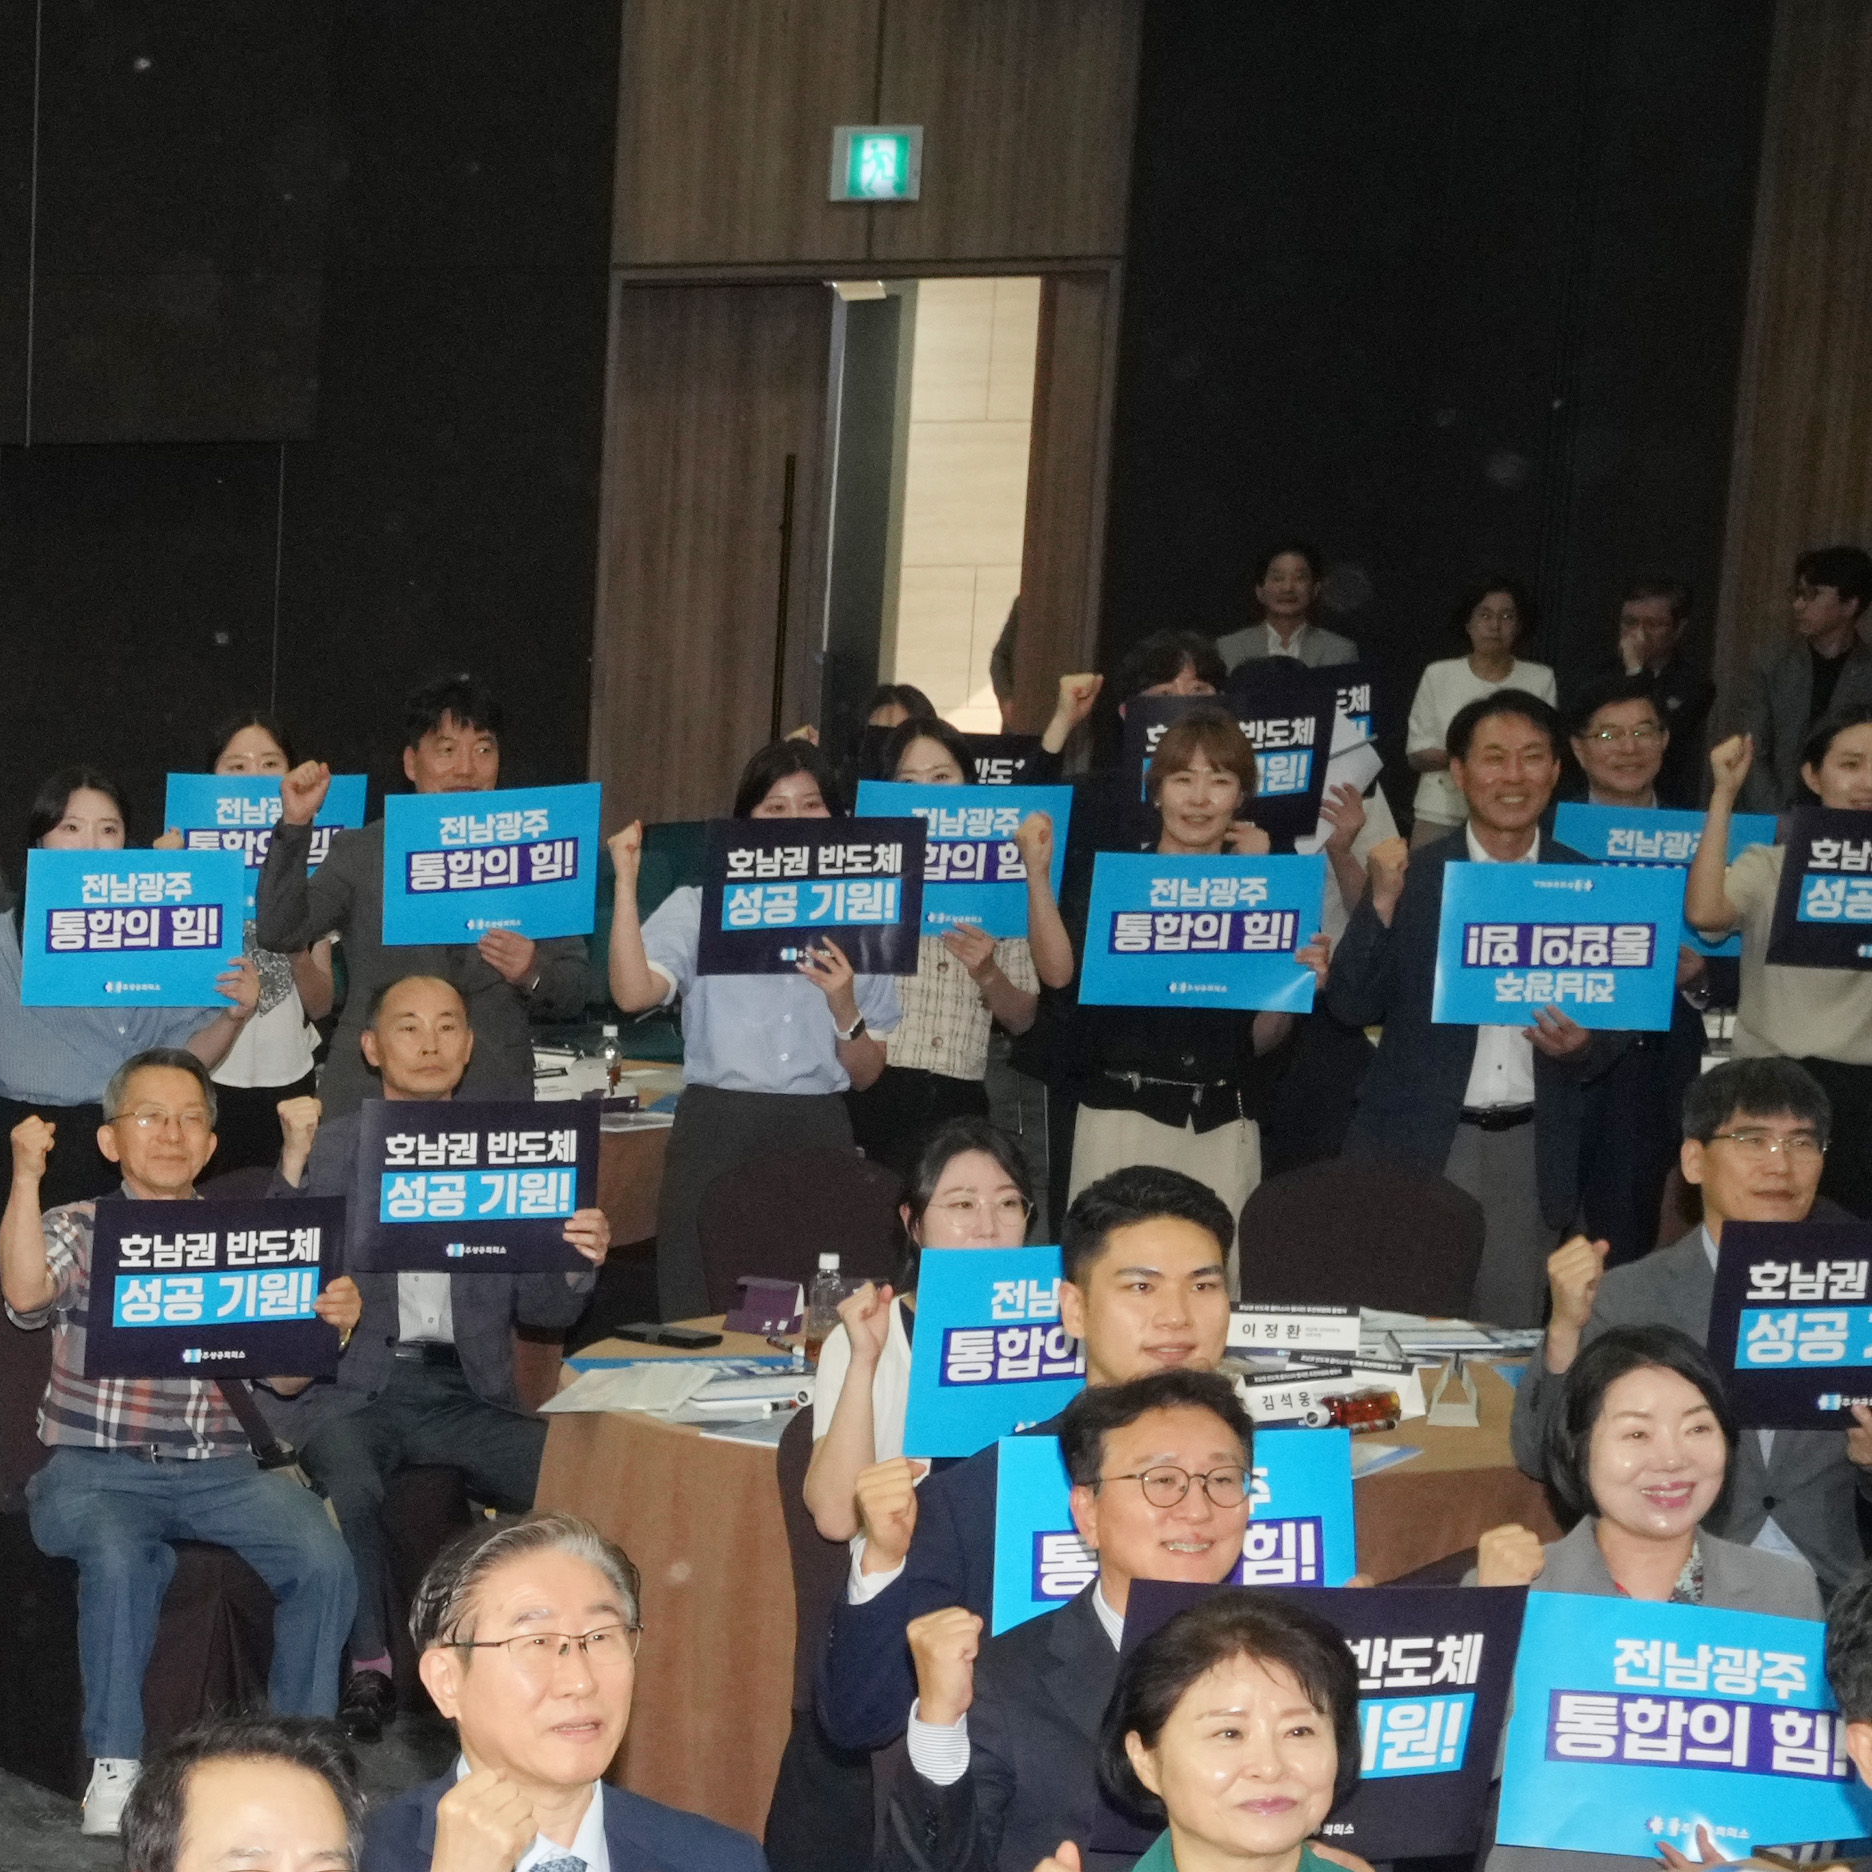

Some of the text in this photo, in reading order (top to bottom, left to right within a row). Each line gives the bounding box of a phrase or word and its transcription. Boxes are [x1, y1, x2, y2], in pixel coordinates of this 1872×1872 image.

[439, 810, 548, 846] 전남광주
[410, 841, 574, 891] 통합의 힘!
[726, 843, 903, 878] 호남권 반도체
[82, 872, 192, 904] 전남광주
[728, 881, 896, 926] 성공 기원!
[1150, 882, 1267, 907] 전남광주
[50, 907, 218, 950] 통합의 힘!
[1114, 912, 1294, 951] 통합의 힘!
[384, 1129, 577, 1166] 호남권 반도체
[387, 1171, 571, 1218] 성공 기원!
[118, 1227, 321, 1268] 호남권 반도체
[121, 1271, 313, 1323] 성공 기원!
[1746, 1260, 1868, 1300] 호남권
[1747, 1312, 1848, 1363] 성공
[1242, 1522, 1316, 1586] 힘!
[1612, 1637, 1807, 1699] 전남광주
[1555, 1694, 1847, 1776] 통합의 힘!
